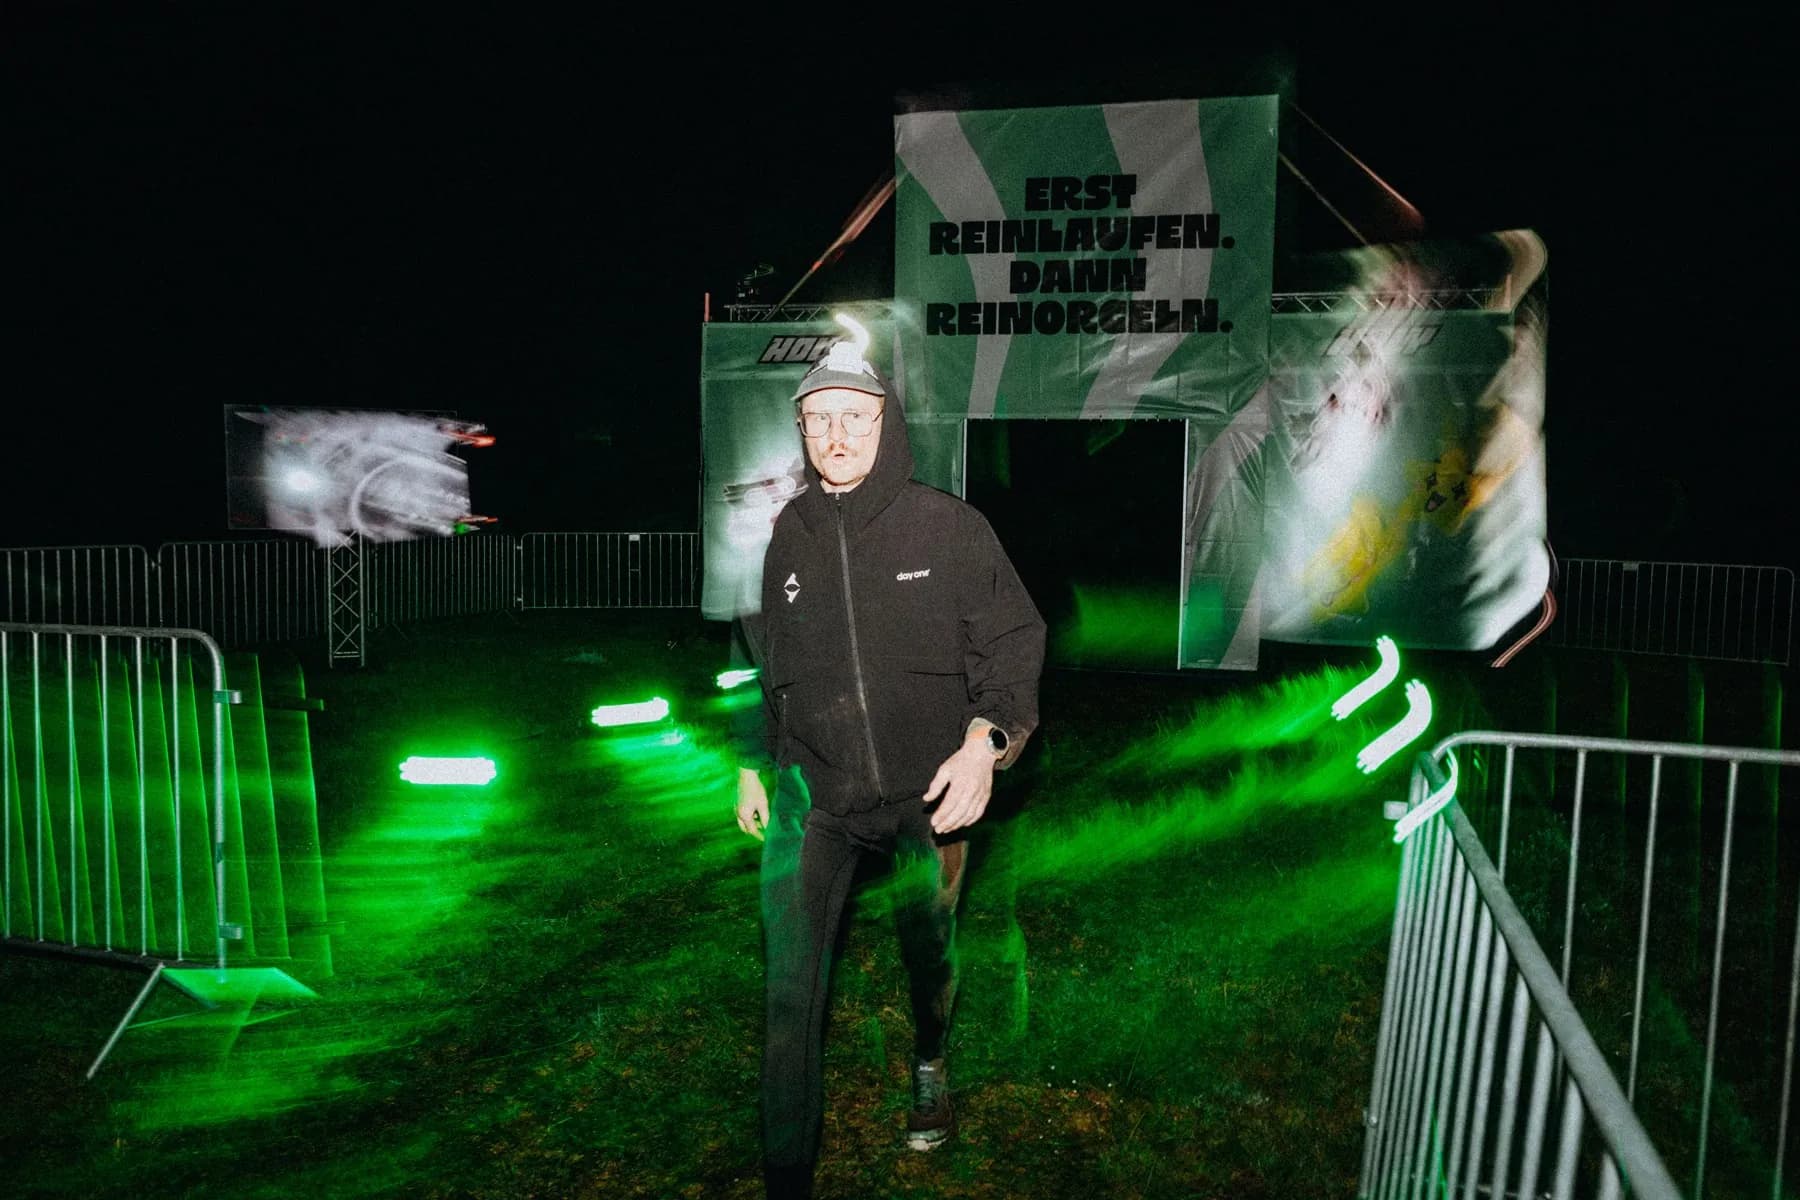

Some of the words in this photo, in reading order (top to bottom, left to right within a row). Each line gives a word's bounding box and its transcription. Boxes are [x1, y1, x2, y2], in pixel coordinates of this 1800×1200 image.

[1025, 174, 1137, 211] ERST
[929, 214, 1235, 255] REINLAUFEN.
[1010, 257, 1147, 294] DANN
[926, 298, 1234, 336] REINORGELN.
[896, 572, 913, 581] day
